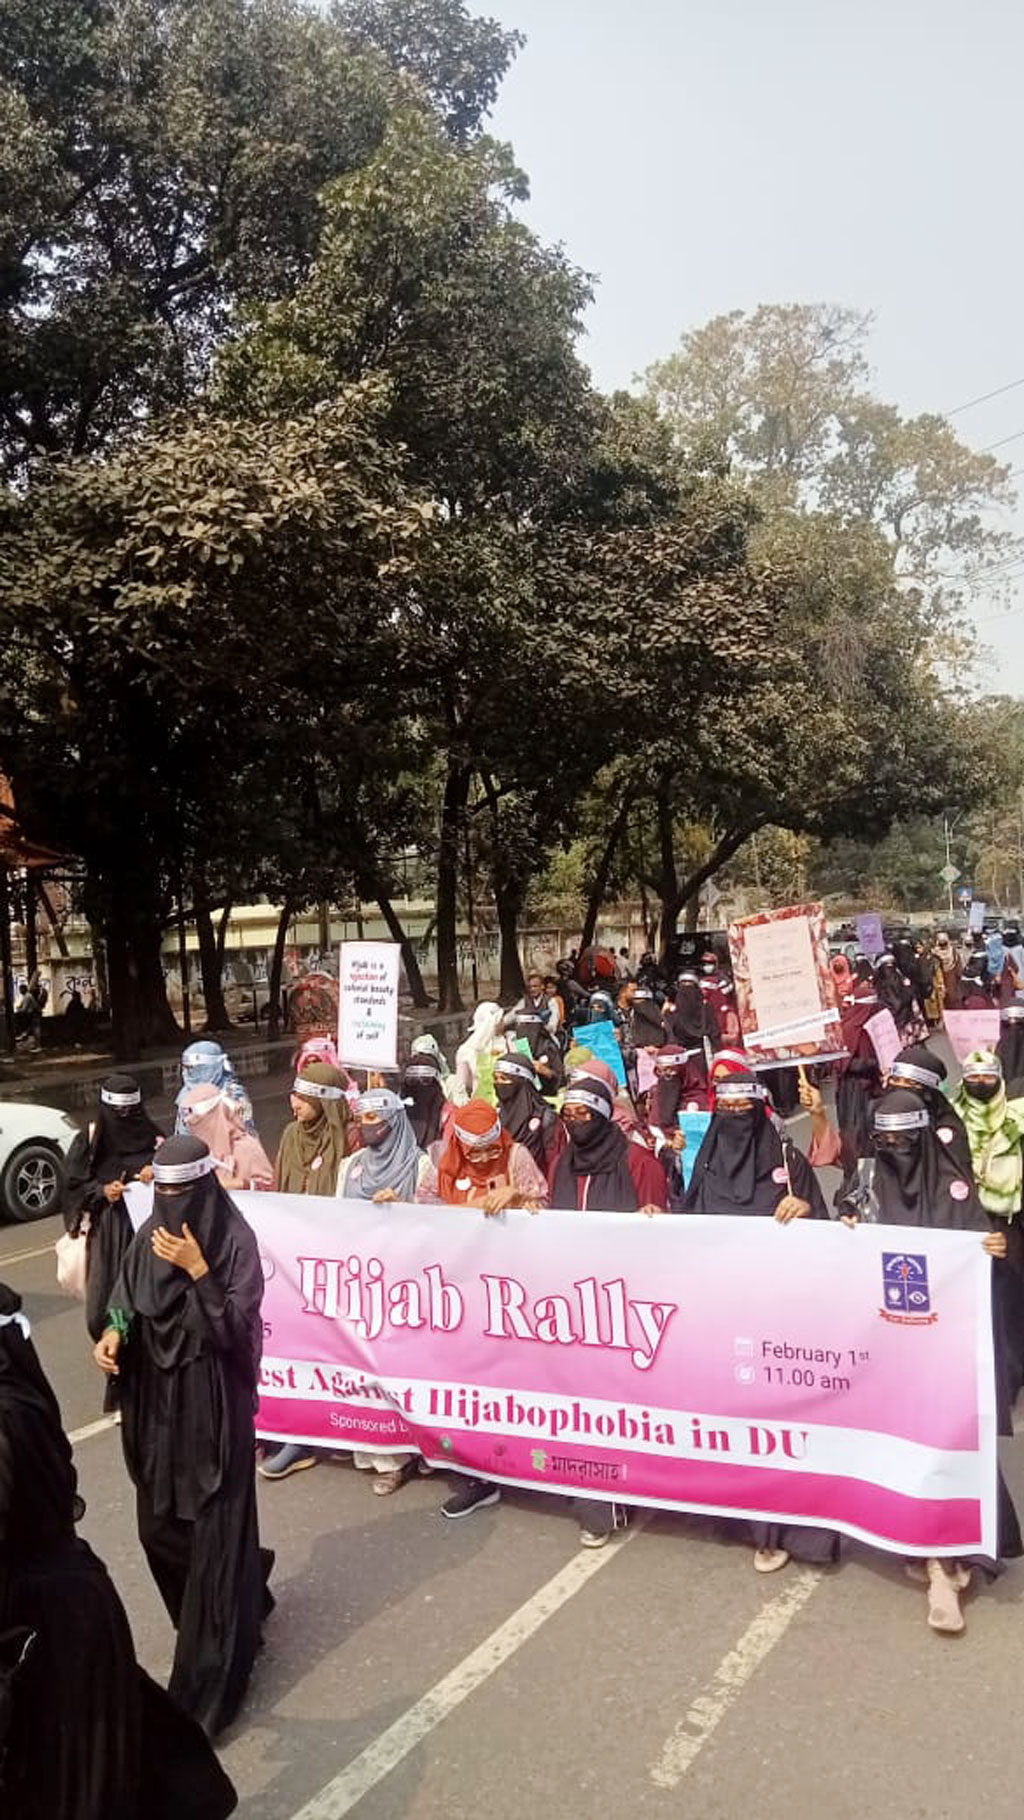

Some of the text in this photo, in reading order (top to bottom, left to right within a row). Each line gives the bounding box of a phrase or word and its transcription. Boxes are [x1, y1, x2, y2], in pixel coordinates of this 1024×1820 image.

[379, 971, 387, 981] of
[353, 996, 386, 1005] standards
[371, 984, 394, 996] beauty
[296, 1255, 678, 1370] Hijab Rally
[762, 1341, 870, 1369] February 1st
[766, 1367, 850, 1391] 11.00 am
[309, 1367, 414, 1412] Against
[429, 1388, 675, 1445] Hijabophobia
[691, 1418, 730, 1452] in
[748, 1425, 810, 1459] DU
[330, 1413, 395, 1433] Sponsored
